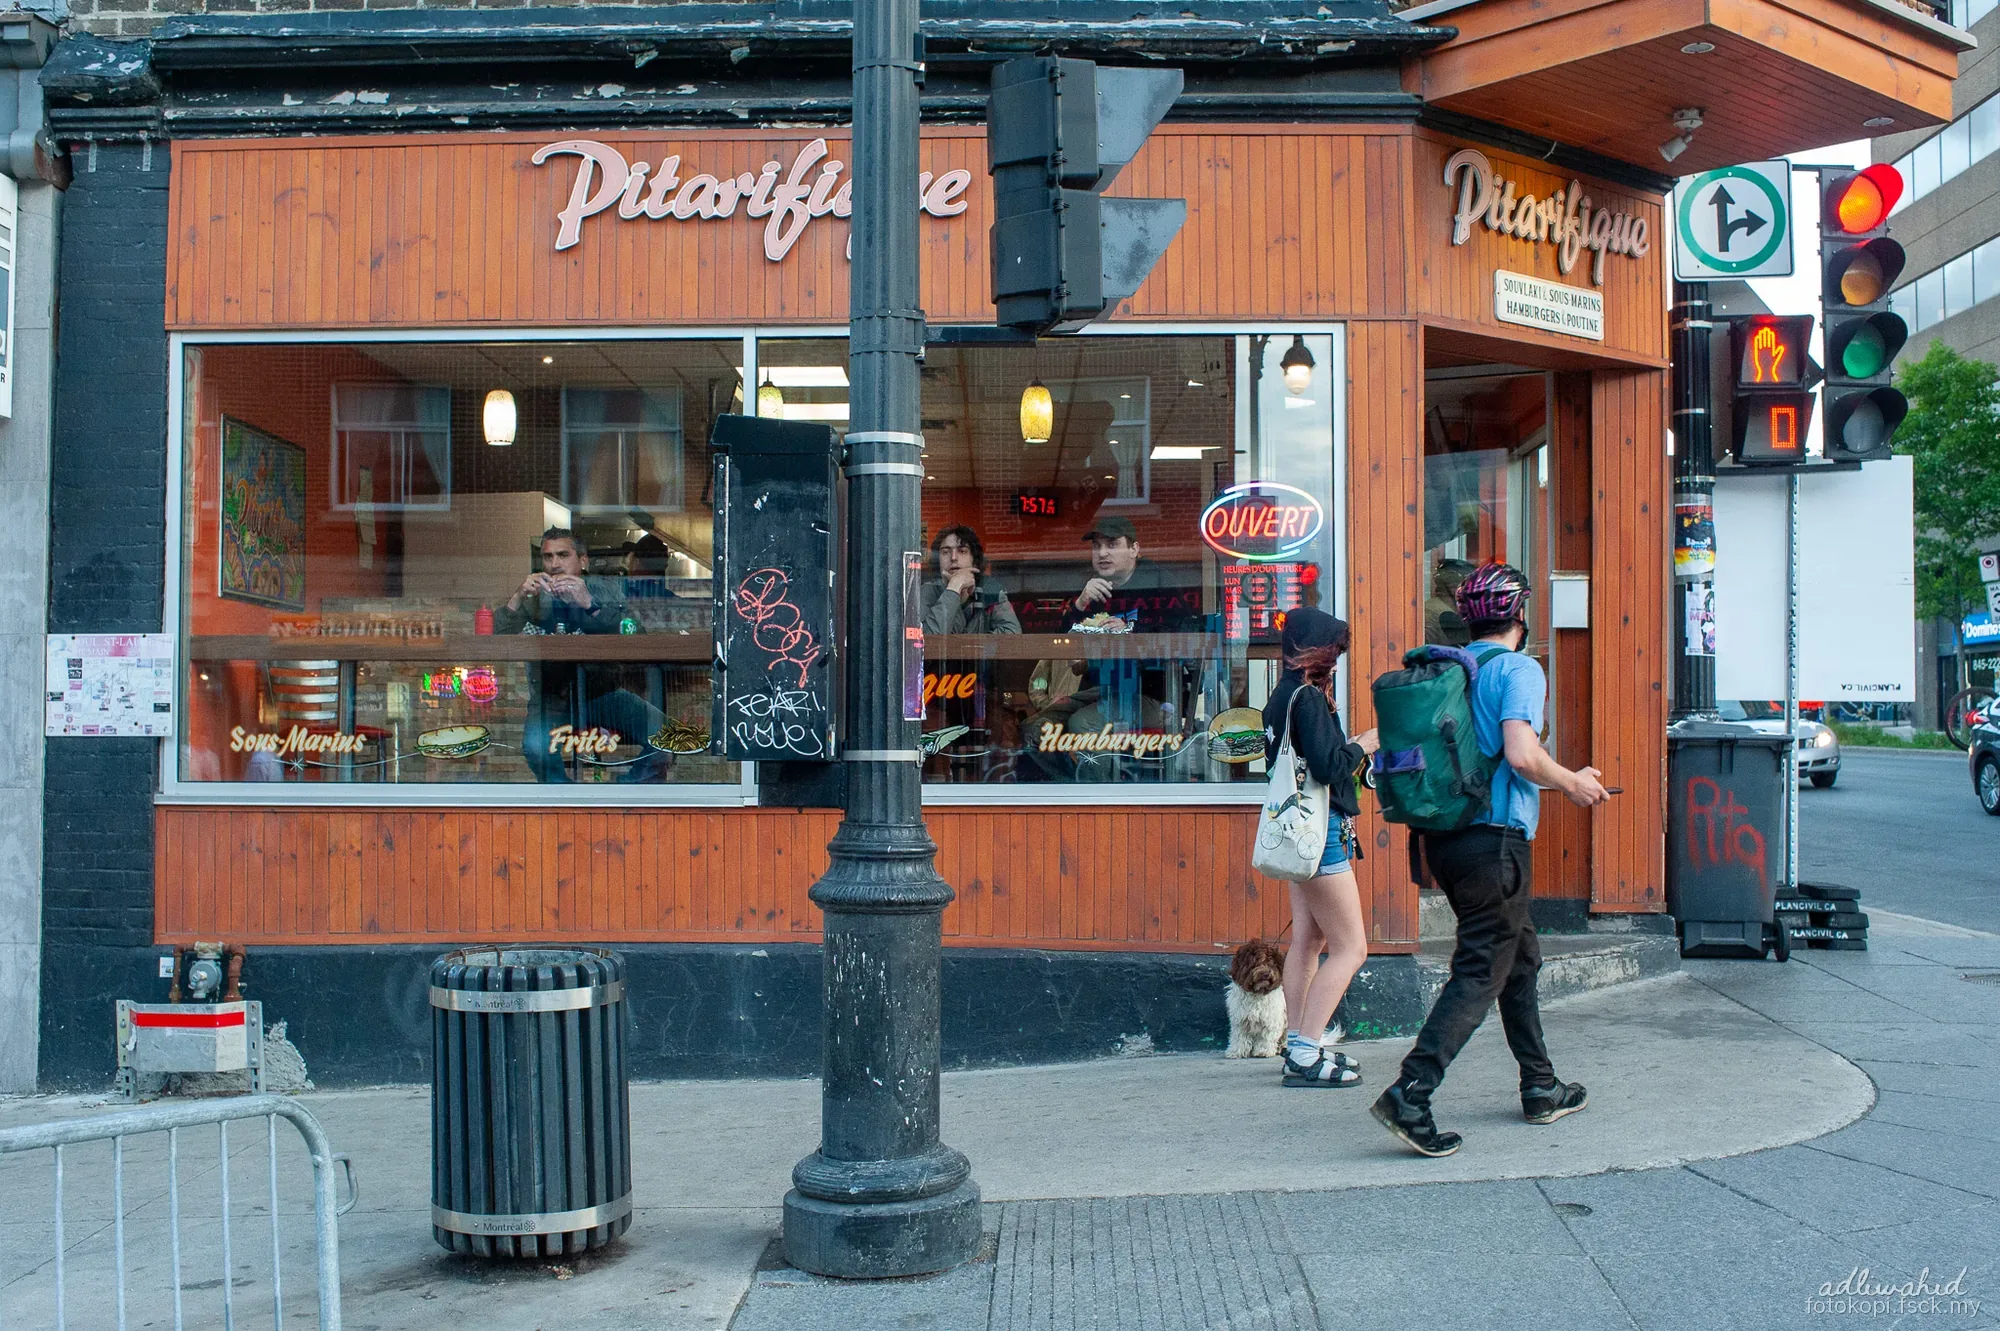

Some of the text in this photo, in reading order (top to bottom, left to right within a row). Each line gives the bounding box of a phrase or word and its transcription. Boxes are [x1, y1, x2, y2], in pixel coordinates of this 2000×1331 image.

[531, 137, 971, 261] Pitarifie
[1444, 149, 1650, 286] Pitarifique
[1504, 278, 1542, 300] SOUVLAKI
[1506, 300, 1561, 324] HAMBURGERS
[1567, 313, 1599, 333] POUTINE
[1771, 406, 1796, 449] 0
[1208, 506, 1315, 538] OUVERT
[1223, 564, 1303, 574] HEURES D'OUVERTURE
[1224, 577, 1241, 586] LUN
[1966, 618, 2000, 639] Domino
[230, 724, 368, 757] Sous-Marins
[549, 724, 622, 754] Frites
[1039, 722, 1184, 759] Hamburgers
[474, 1000, 514, 1009] Mntréal
[483, 1222, 524, 1232] Montréal
